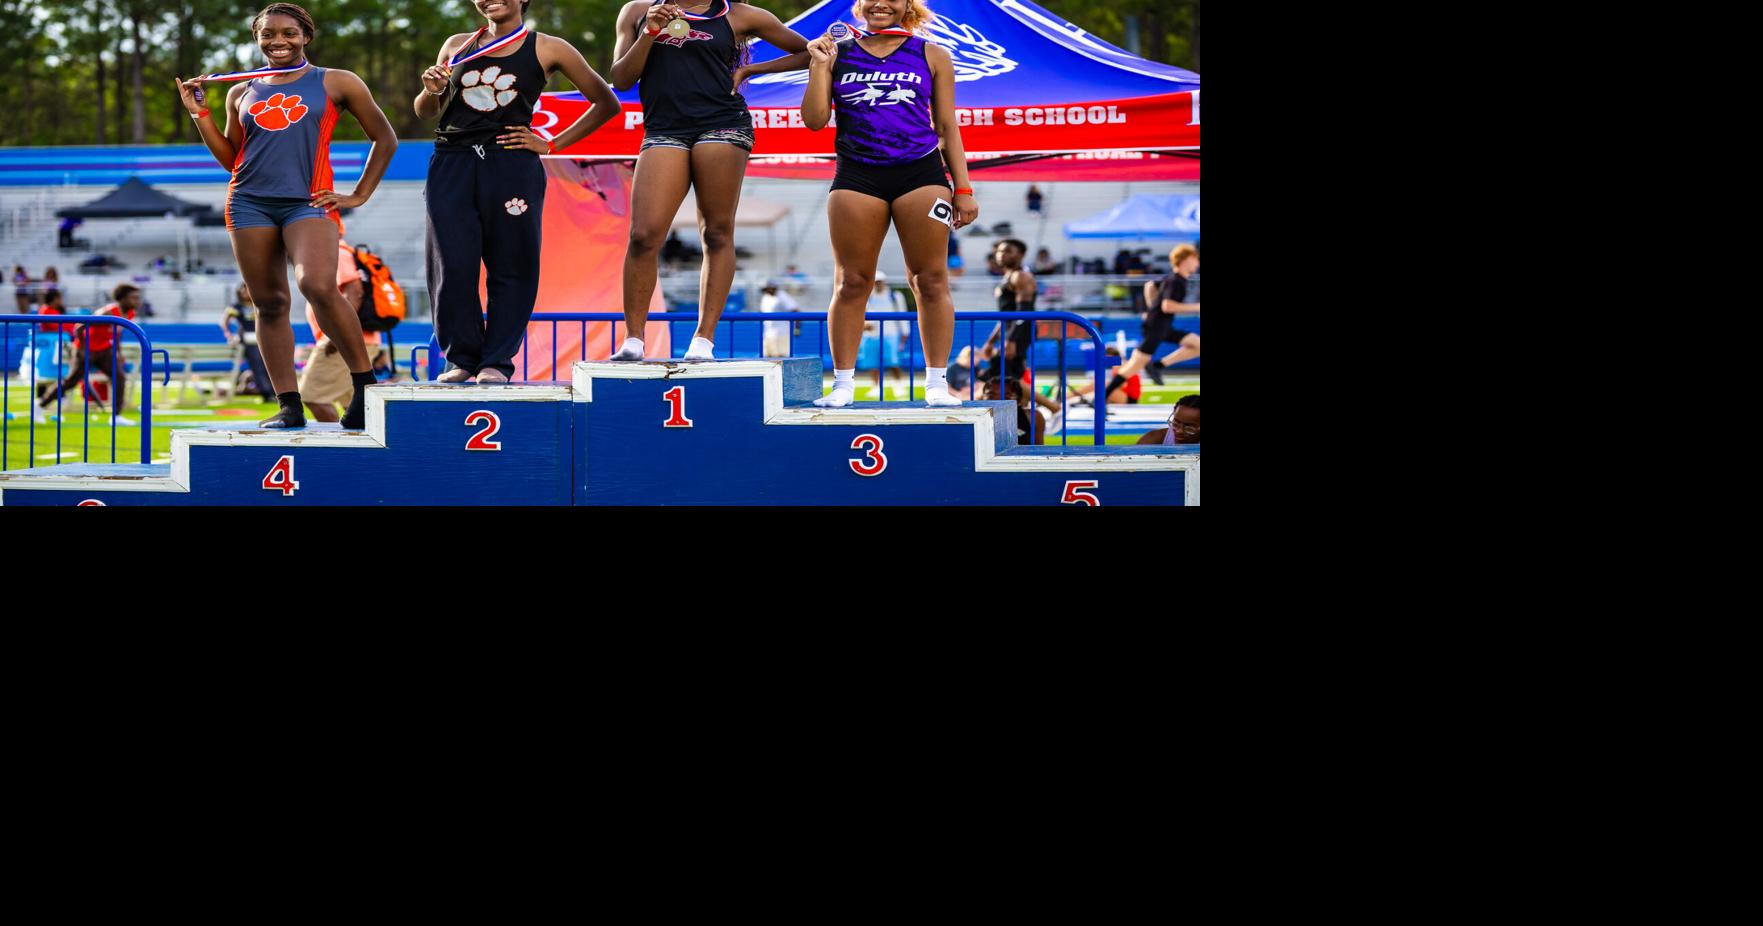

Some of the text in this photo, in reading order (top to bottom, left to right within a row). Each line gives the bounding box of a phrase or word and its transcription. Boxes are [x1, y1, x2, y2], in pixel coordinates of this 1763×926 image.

[840, 71, 922, 85] Duluth
[954, 105, 1127, 126] GH SCHOOL
[663, 385, 693, 428] 1
[464, 410, 501, 451] 2
[262, 455, 299, 496] 4
[848, 433, 888, 477] 3
[1060, 480, 1101, 506] 5
